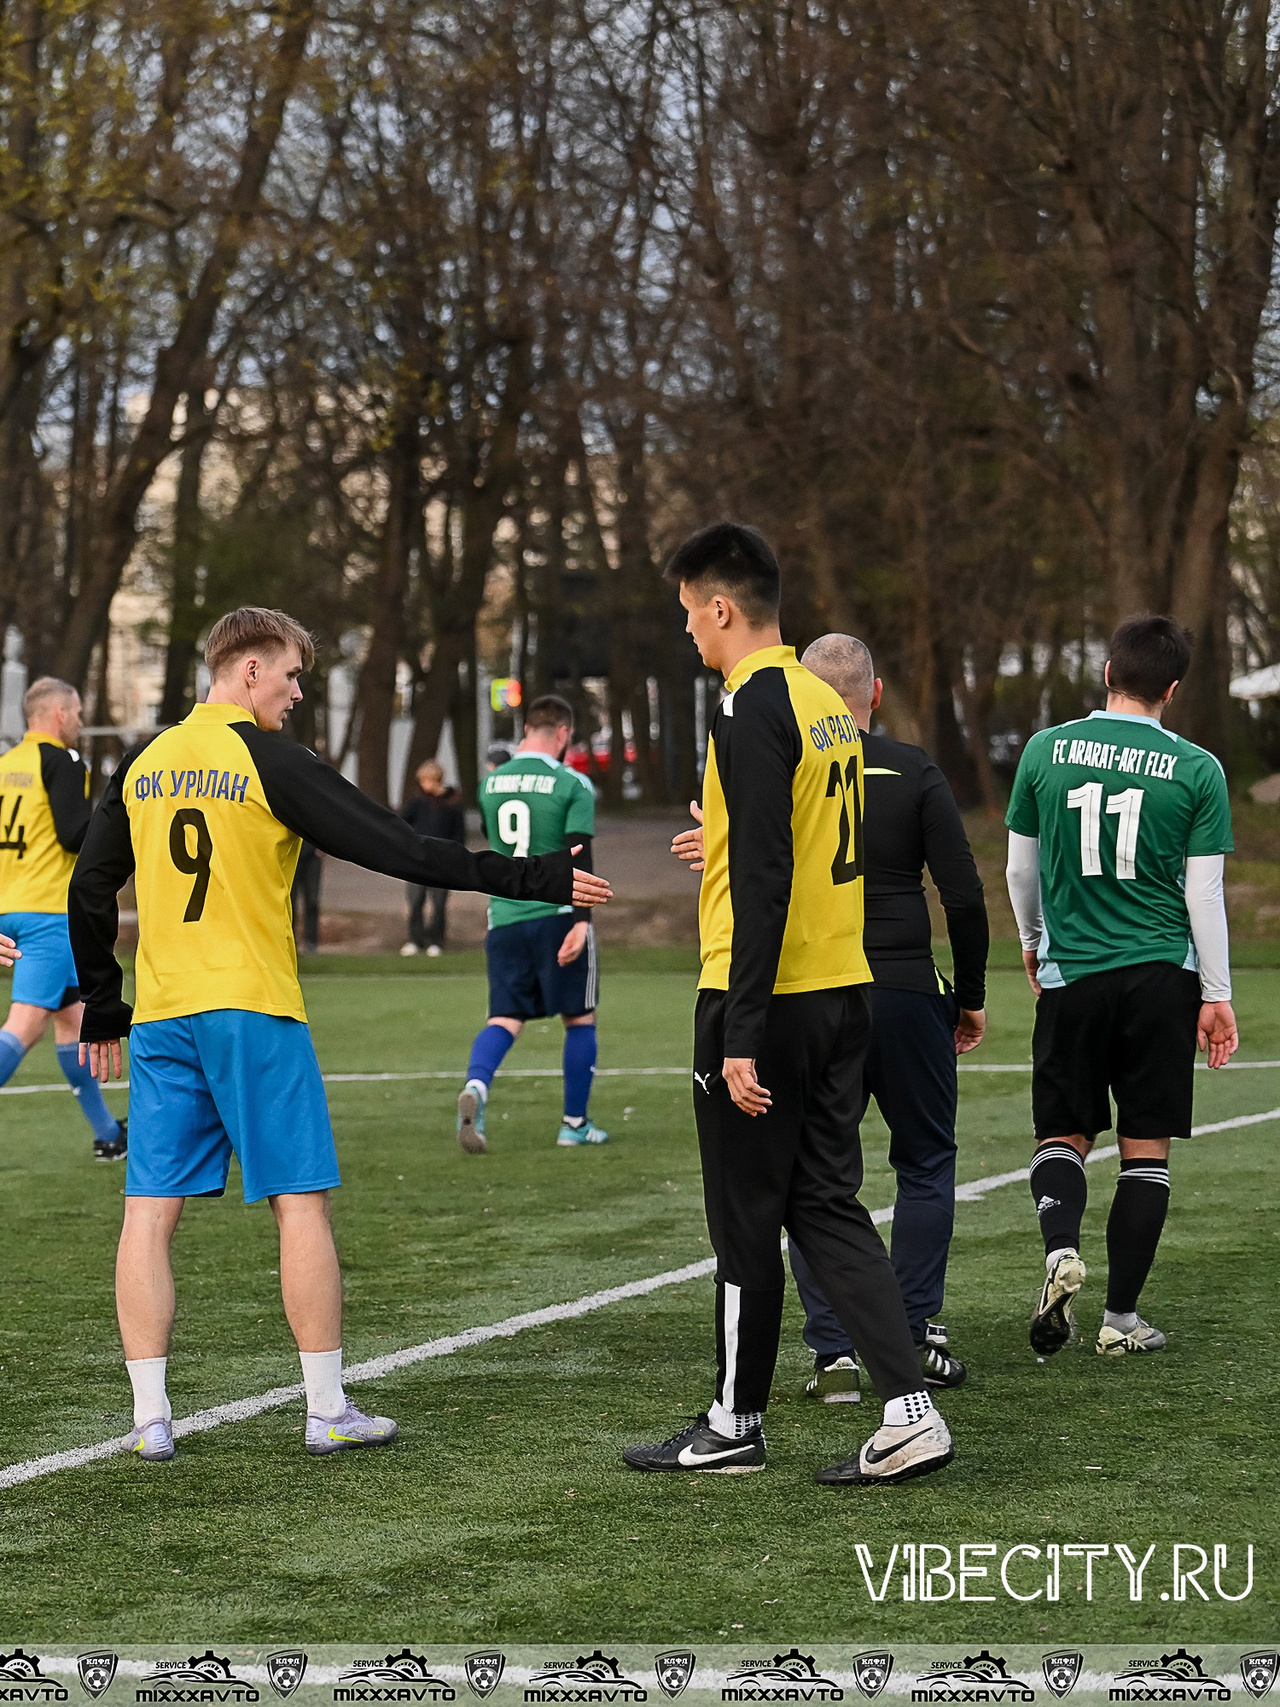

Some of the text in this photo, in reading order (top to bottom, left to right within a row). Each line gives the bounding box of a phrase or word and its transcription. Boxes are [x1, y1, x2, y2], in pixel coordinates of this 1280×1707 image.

[809, 718, 835, 752] ФК
[1052, 739, 1179, 781] FC ARARAT-ART FLEX
[135, 769, 250, 803] ФК УРАЛАН
[498, 799, 531, 859] 9
[825, 755, 865, 886] 21
[1066, 781, 1145, 880] 11
[169, 808, 213, 923] 9
